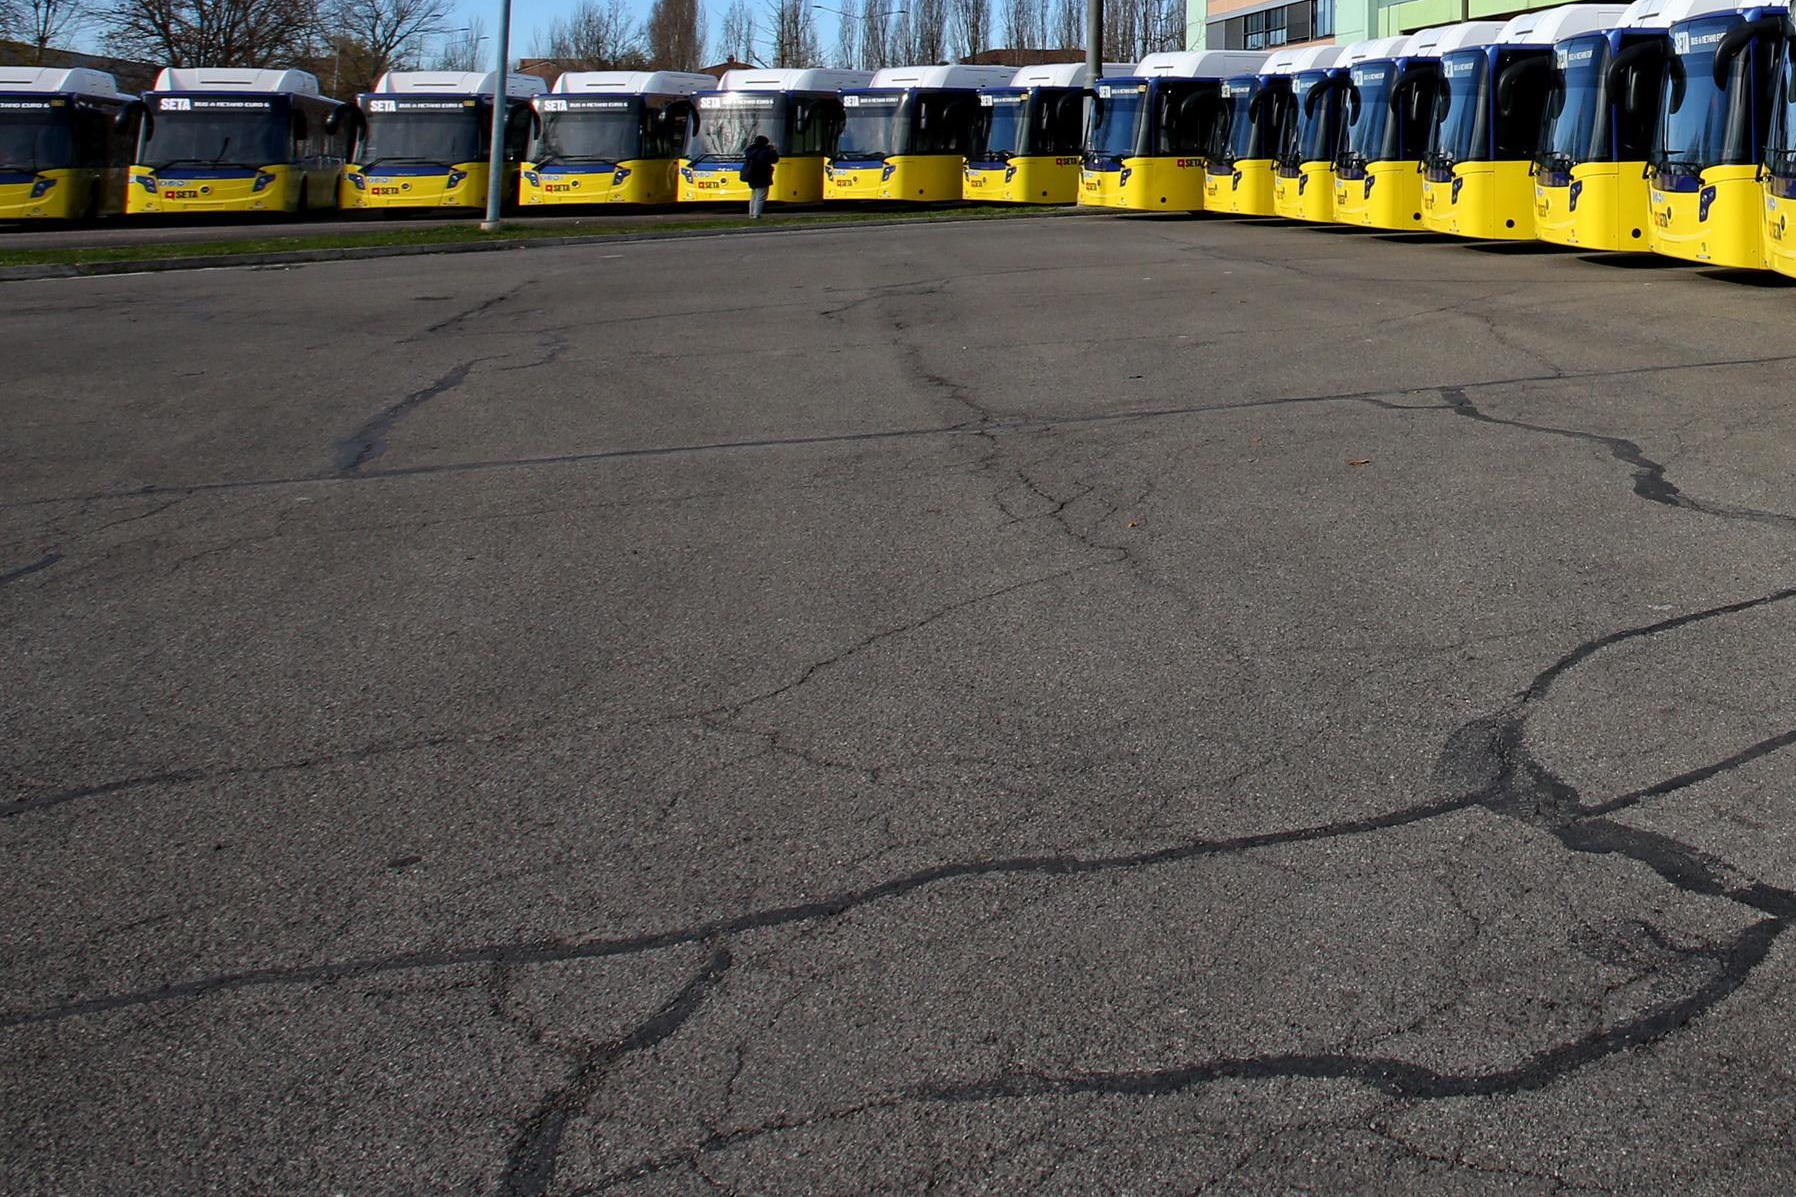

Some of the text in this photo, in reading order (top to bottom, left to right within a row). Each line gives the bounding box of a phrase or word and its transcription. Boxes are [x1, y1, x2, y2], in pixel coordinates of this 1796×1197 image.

[160, 98, 191, 111] SETA
[370, 100, 396, 112] SETA
[544, 100, 568, 111] SETA
